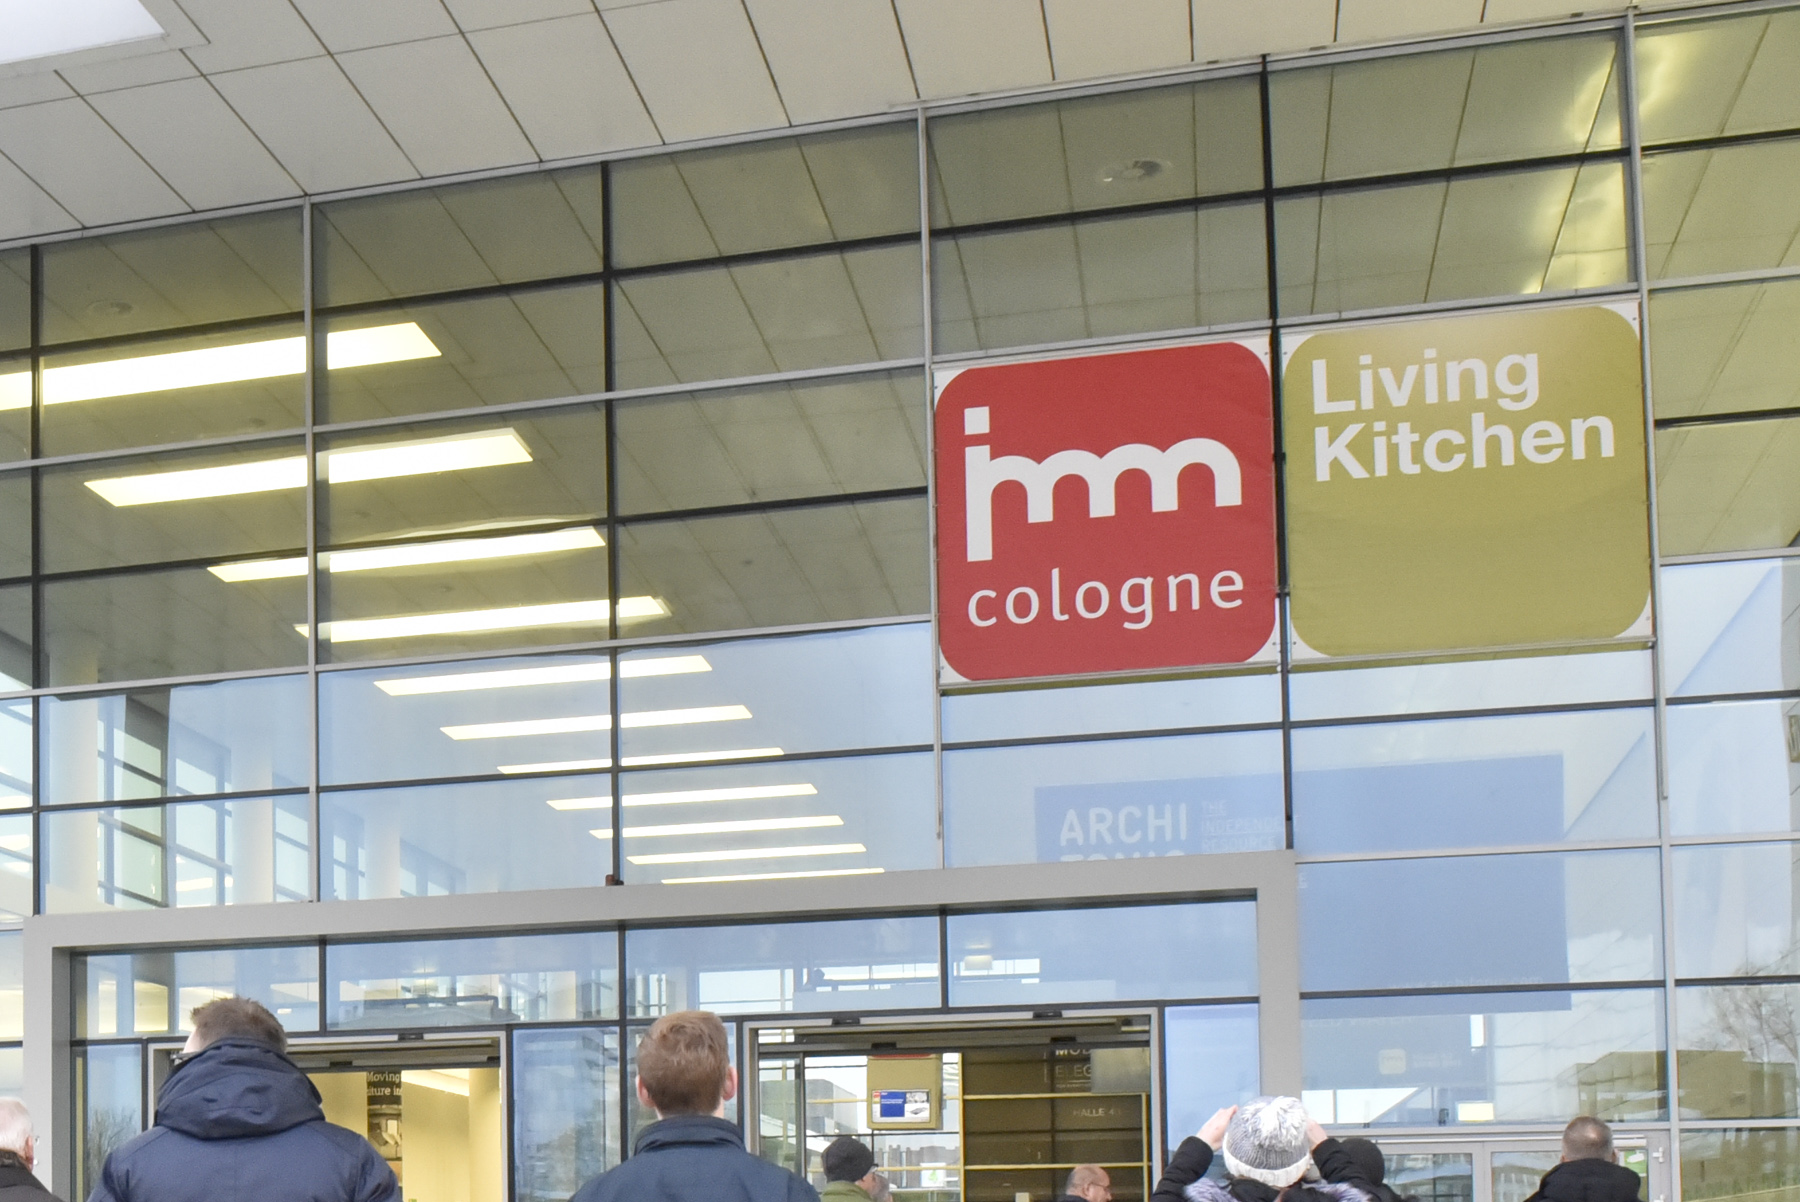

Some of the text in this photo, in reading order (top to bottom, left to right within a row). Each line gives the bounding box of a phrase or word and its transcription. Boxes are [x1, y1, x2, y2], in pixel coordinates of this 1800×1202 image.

[1312, 348, 1540, 414] Living
[1314, 412, 1615, 482] Kitchen
[964, 406, 1243, 562] imm
[968, 567, 1245, 630] cologne
[1059, 803, 1188, 847] ARCHI
